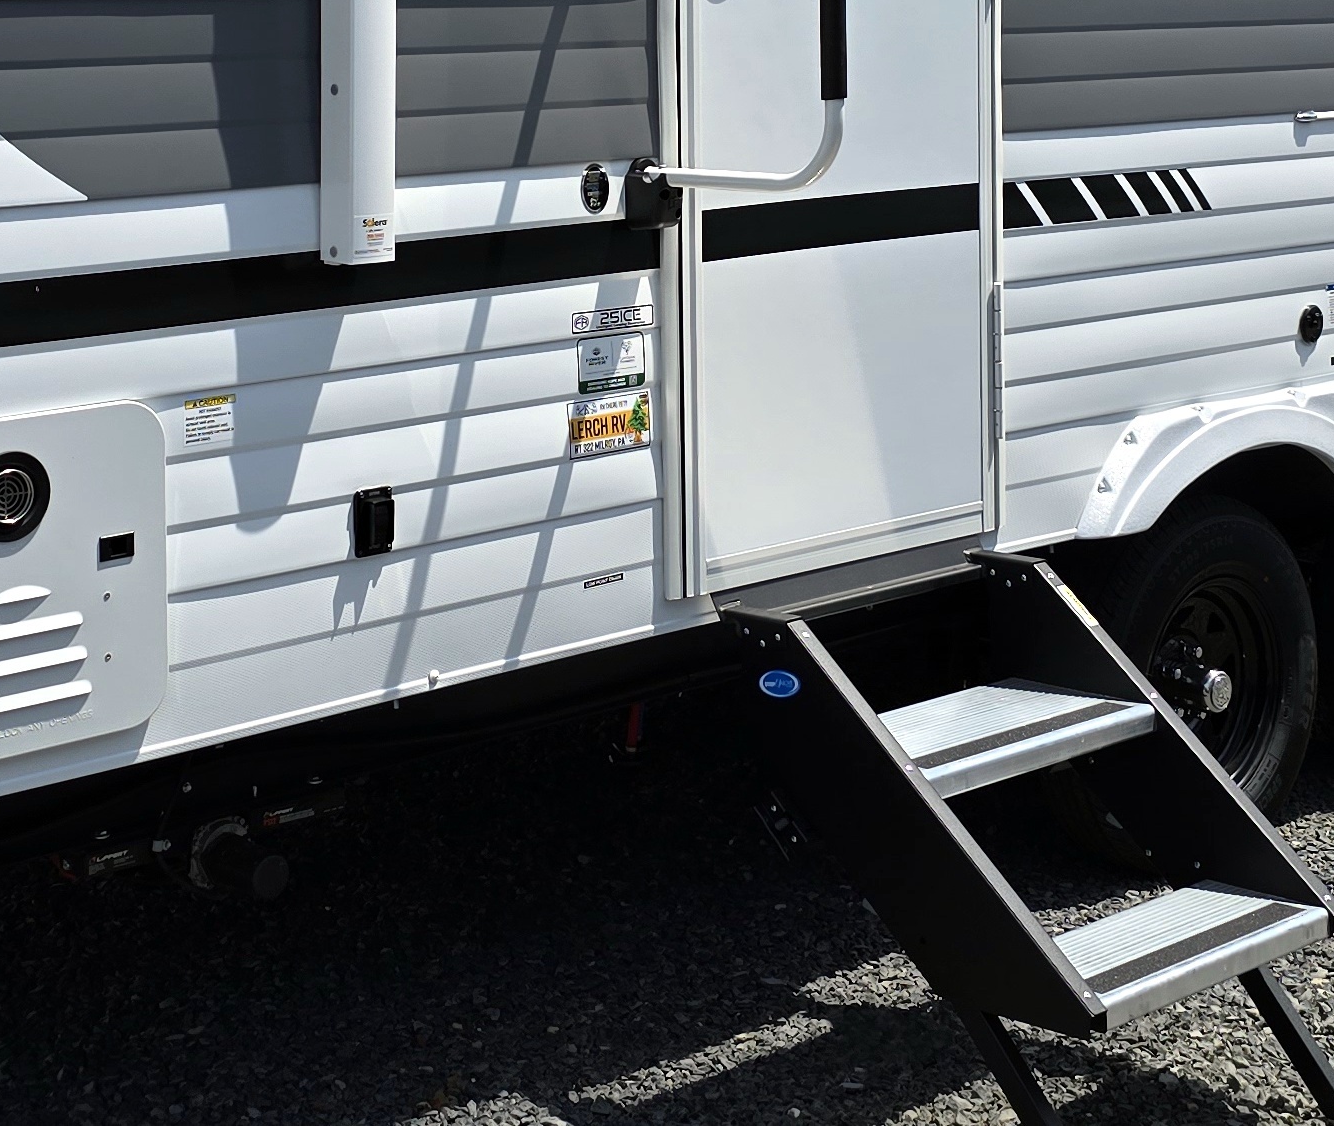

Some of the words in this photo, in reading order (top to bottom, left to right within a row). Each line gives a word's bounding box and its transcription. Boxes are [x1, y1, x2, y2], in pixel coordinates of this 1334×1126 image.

[362, 218, 388, 227] Solera
[199, 395, 228, 406] CAUTION
[571, 416, 608, 440] LERCH
[611, 413, 627, 434] RV
